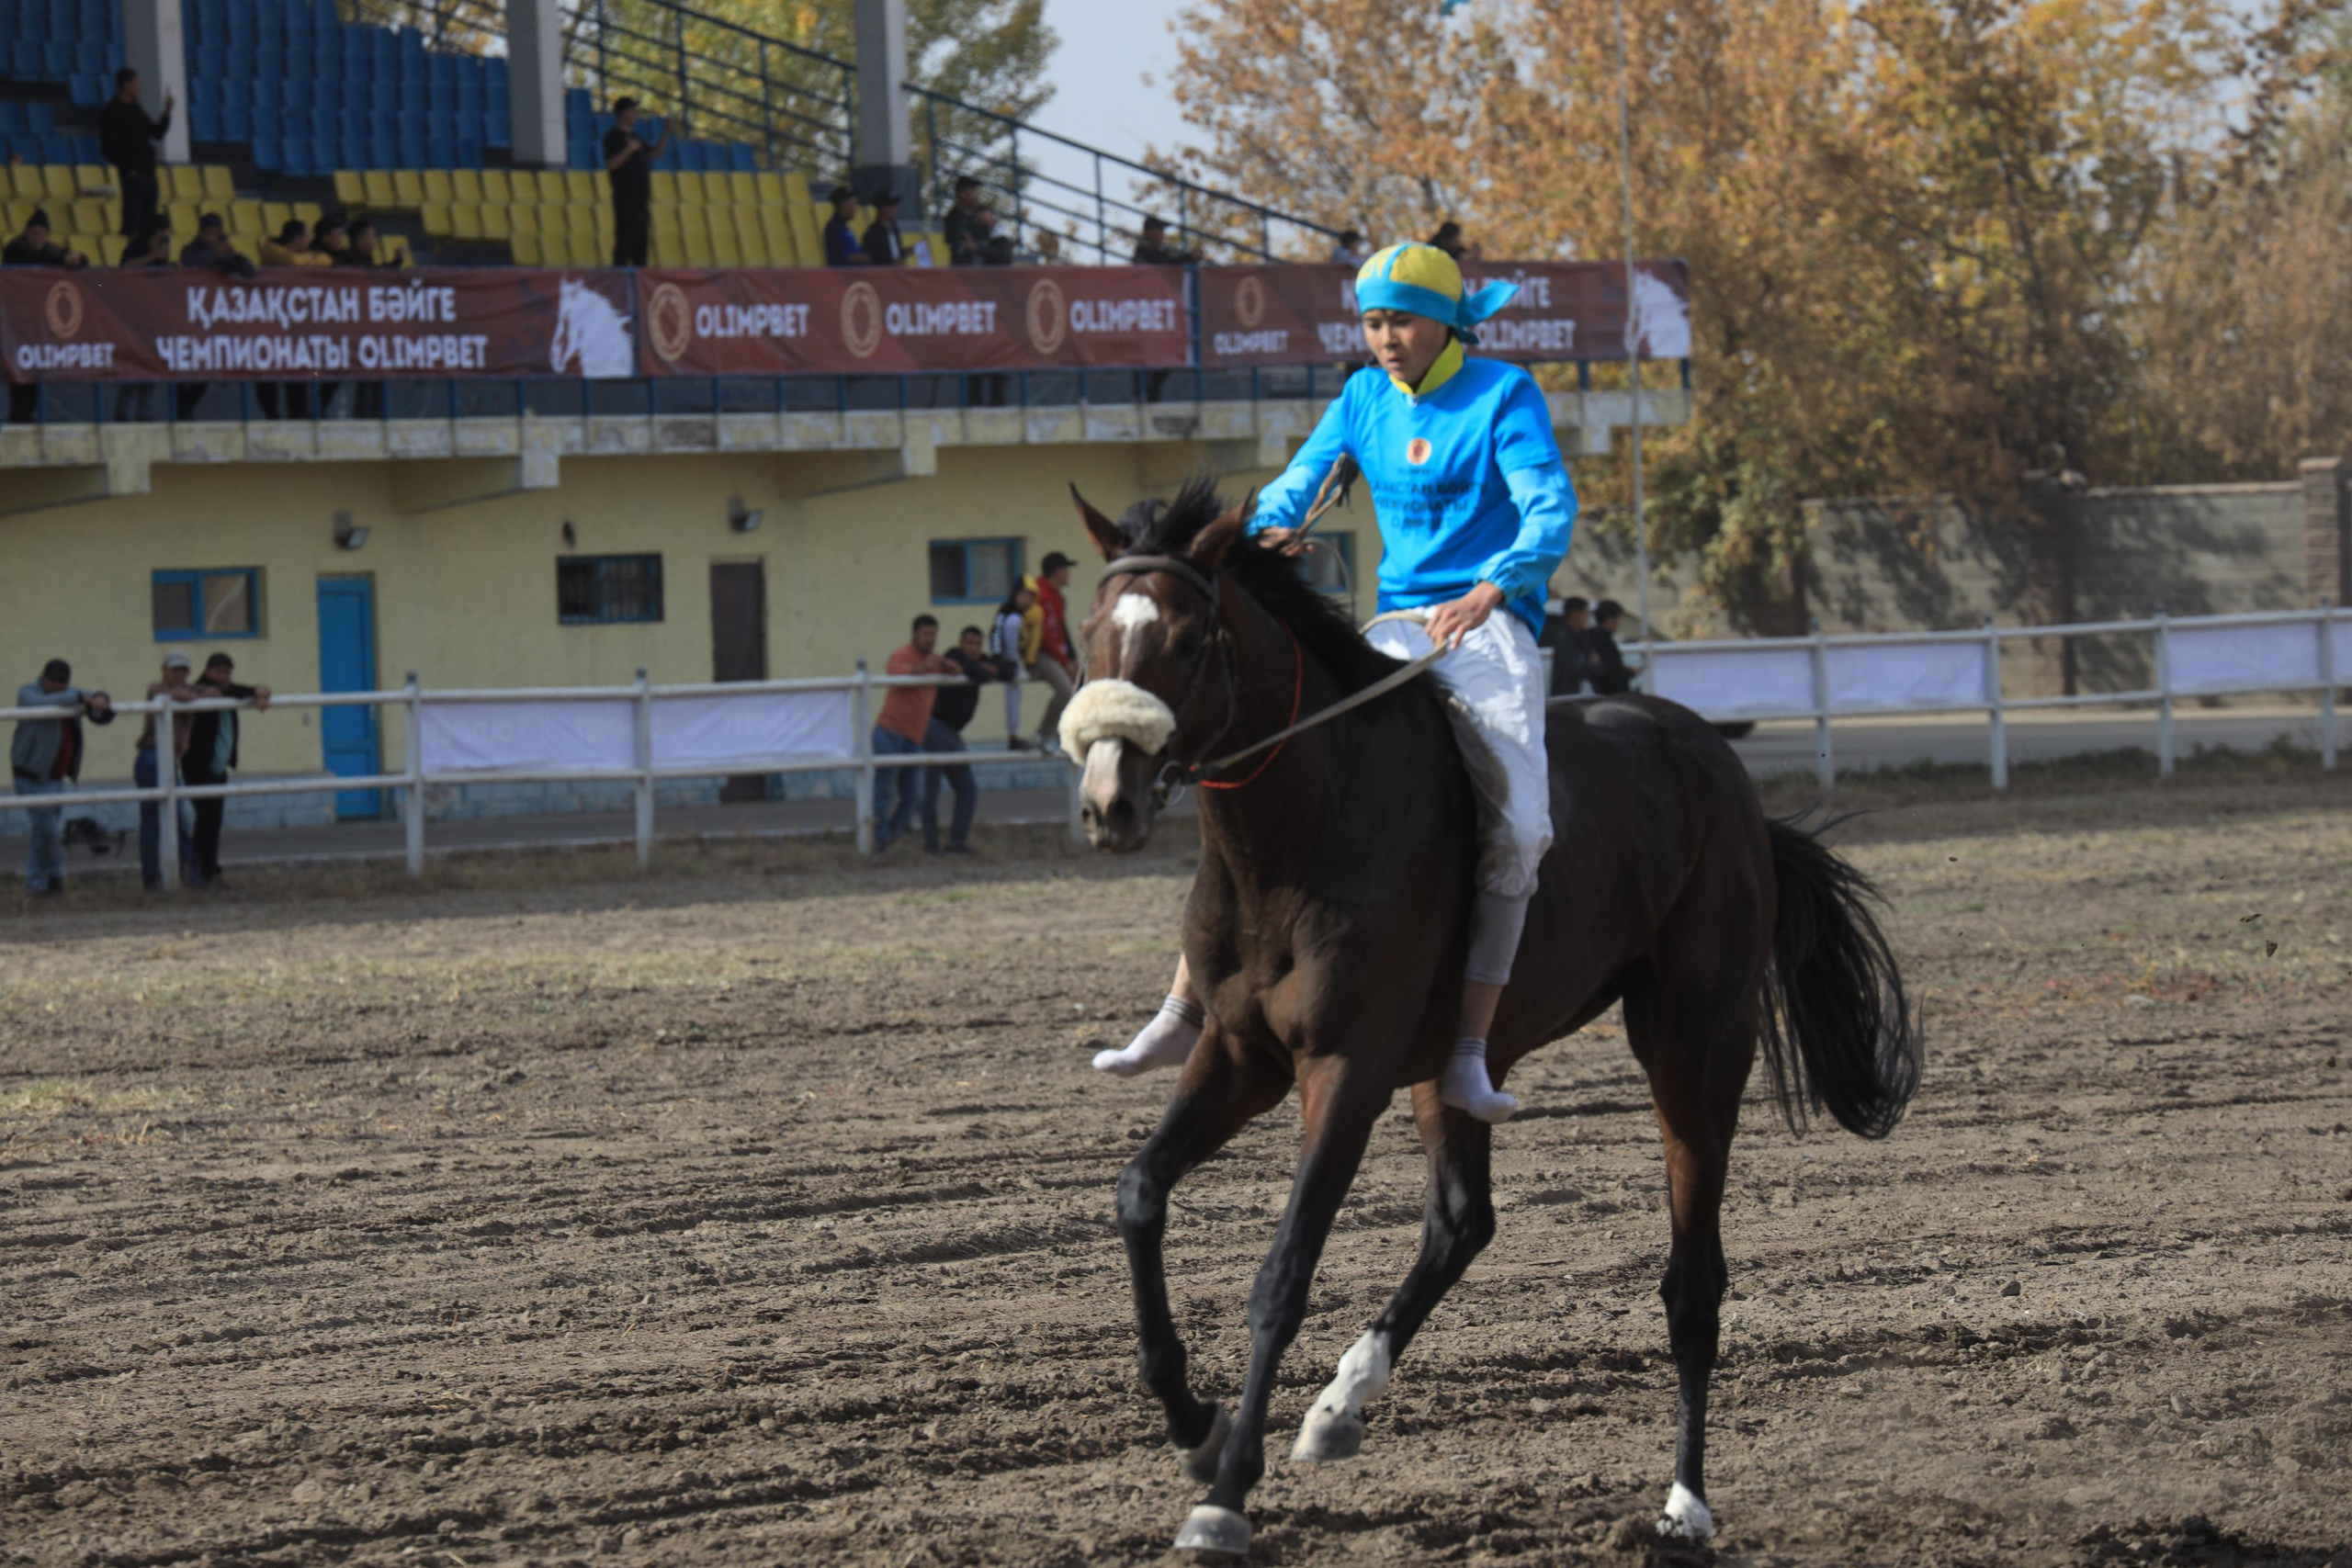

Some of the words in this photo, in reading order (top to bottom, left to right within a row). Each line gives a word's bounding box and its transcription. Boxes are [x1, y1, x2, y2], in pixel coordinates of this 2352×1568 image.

[187, 286, 360, 330] ҚАЗАҚСТАН
[368, 277, 457, 321] БӘЙГЕ
[1481, 269, 1552, 308] ЙГЕ
[695, 304, 808, 337] OLIMPBET
[885, 302, 996, 335] OLIMPBET
[1069, 299, 1175, 333] OLIMPBET
[1213, 331, 1289, 355] OLIMPBET
[1475, 320, 1577, 351] OLIMPBET
[17, 343, 116, 370] OLIMPBET
[155, 334, 350, 371] ЧЕМПИОНАТЫ
[358, 334, 489, 368] OLIMPBET
